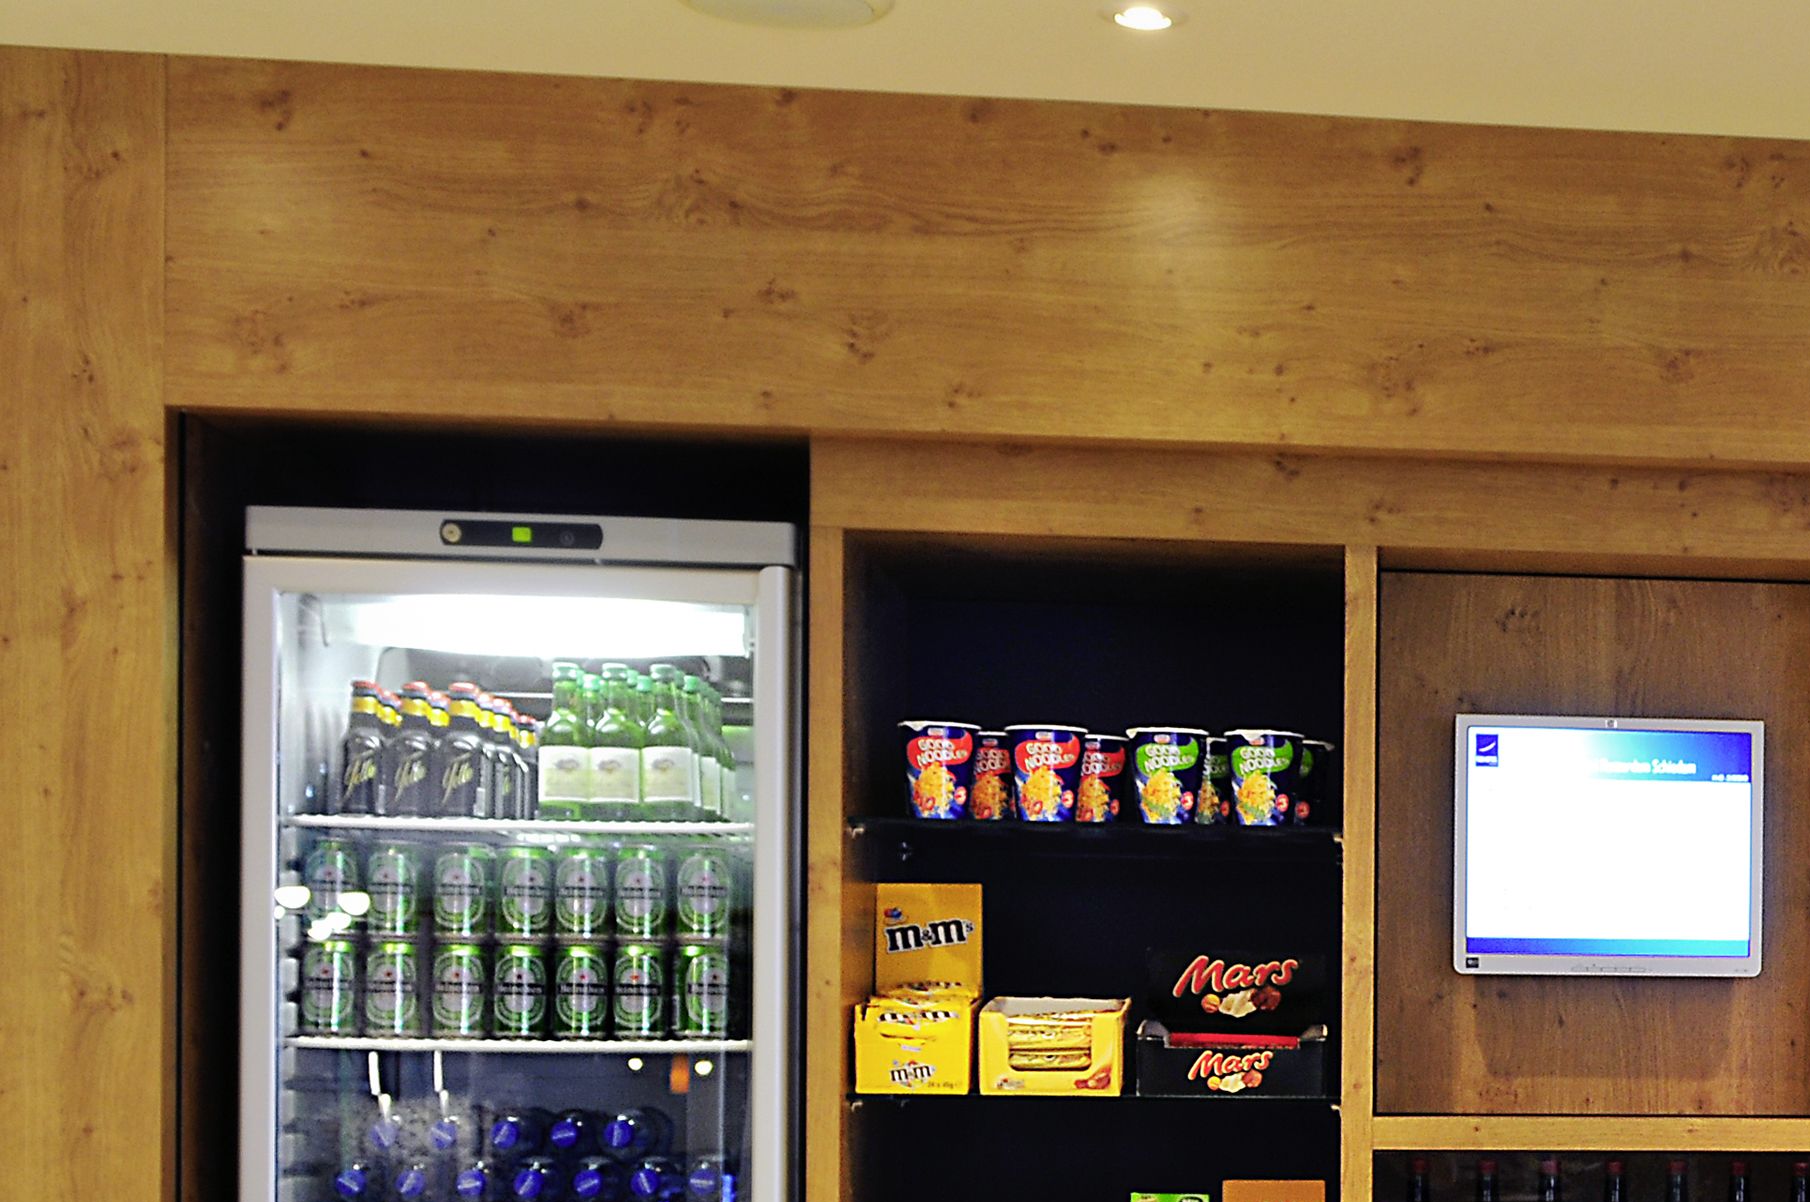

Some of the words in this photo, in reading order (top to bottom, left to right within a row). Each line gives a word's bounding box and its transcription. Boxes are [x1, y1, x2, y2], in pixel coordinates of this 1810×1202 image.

[917, 738, 956, 752] GOOD
[1025, 742, 1063, 755] GOOD
[1145, 743, 1181, 758] GOOD
[1239, 746, 1276, 760] GOOD
[1173, 955, 1299, 998] Mars
[1187, 1050, 1274, 1081] Mars
